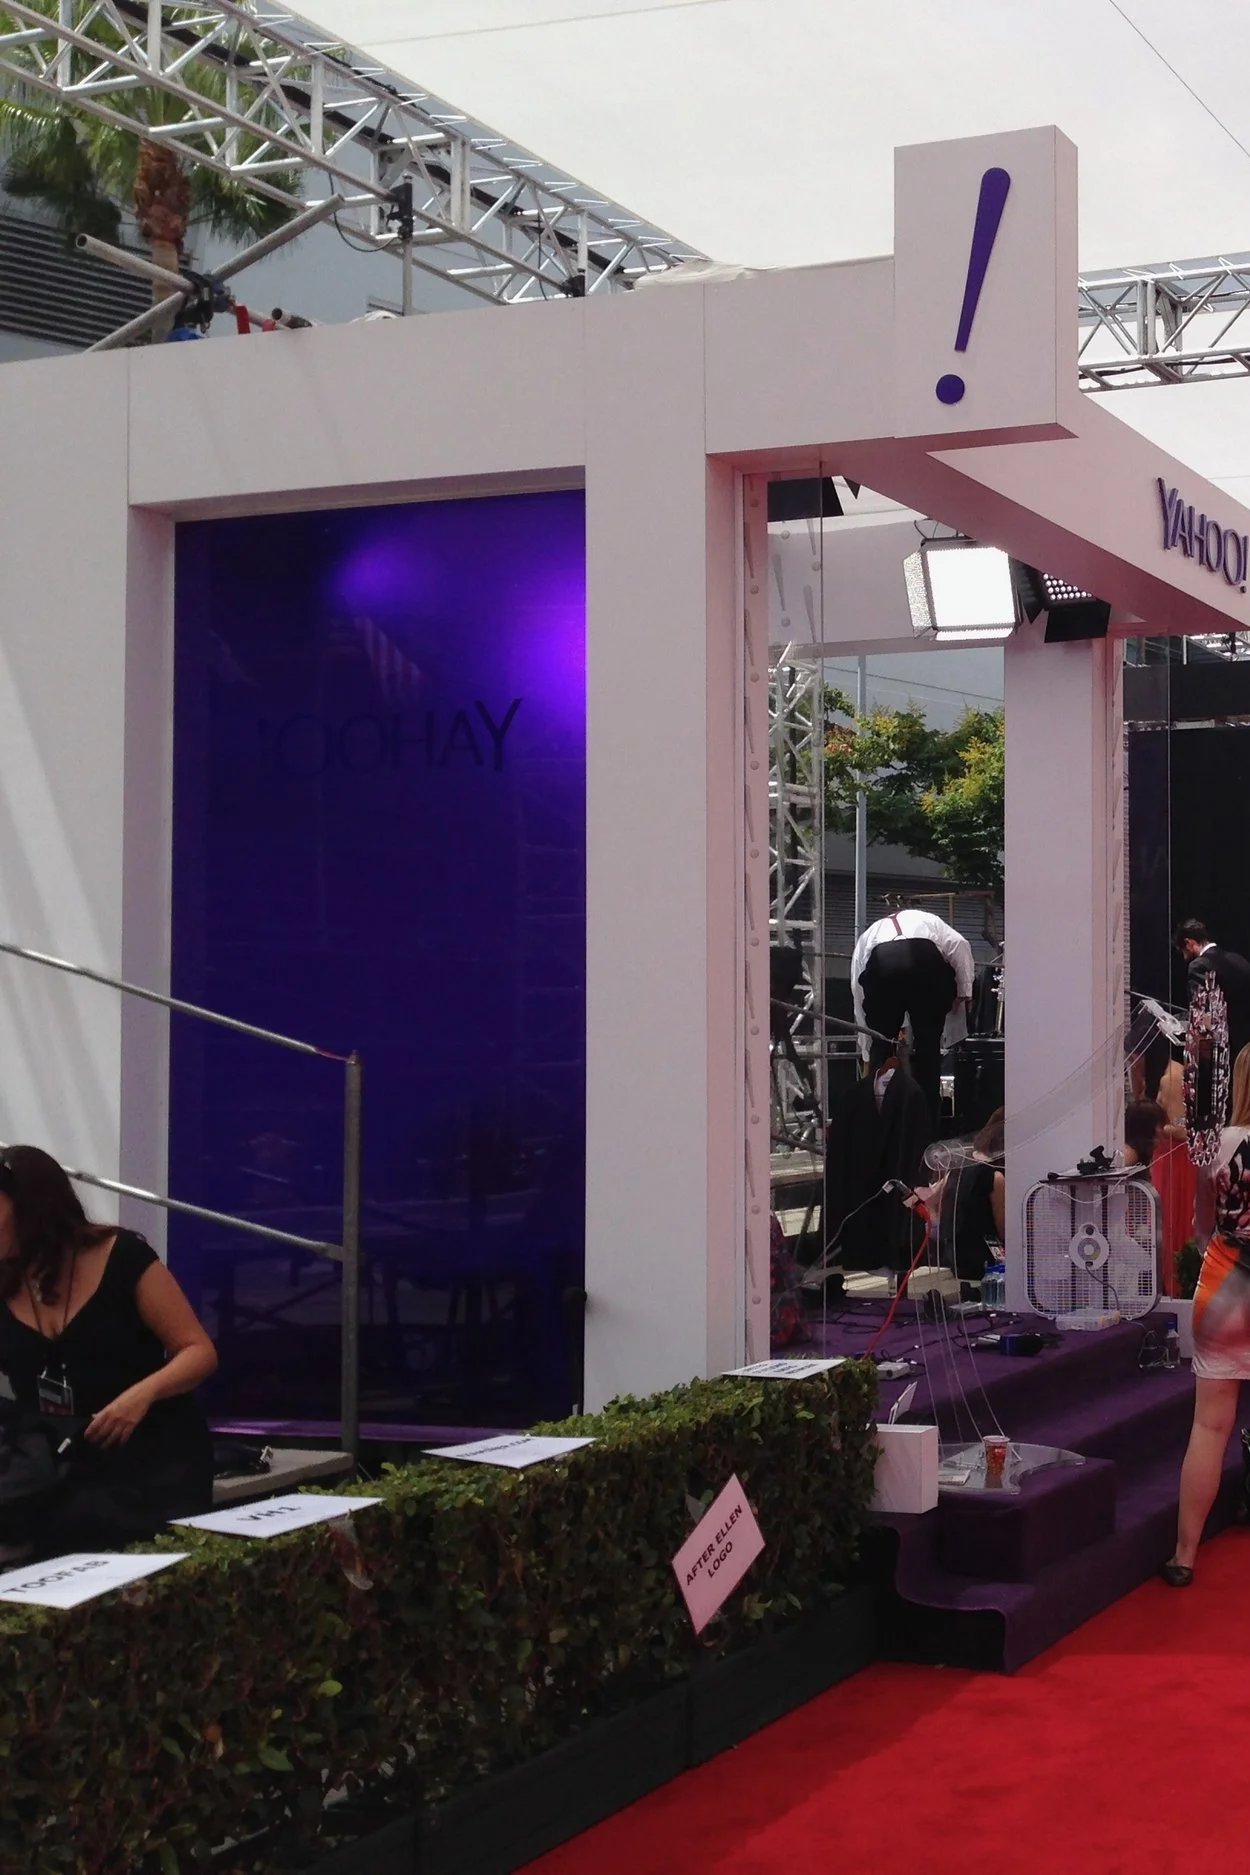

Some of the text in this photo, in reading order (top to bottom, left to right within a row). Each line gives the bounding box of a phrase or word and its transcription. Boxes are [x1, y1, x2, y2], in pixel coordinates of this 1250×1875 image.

[1157, 477, 1248, 594] YAHOO!
[686, 1504, 743, 1586] AFTER ELLEN
[707, 1541, 734, 1578] LOGO
[2, 1560, 110, 1594] TOOFAB
